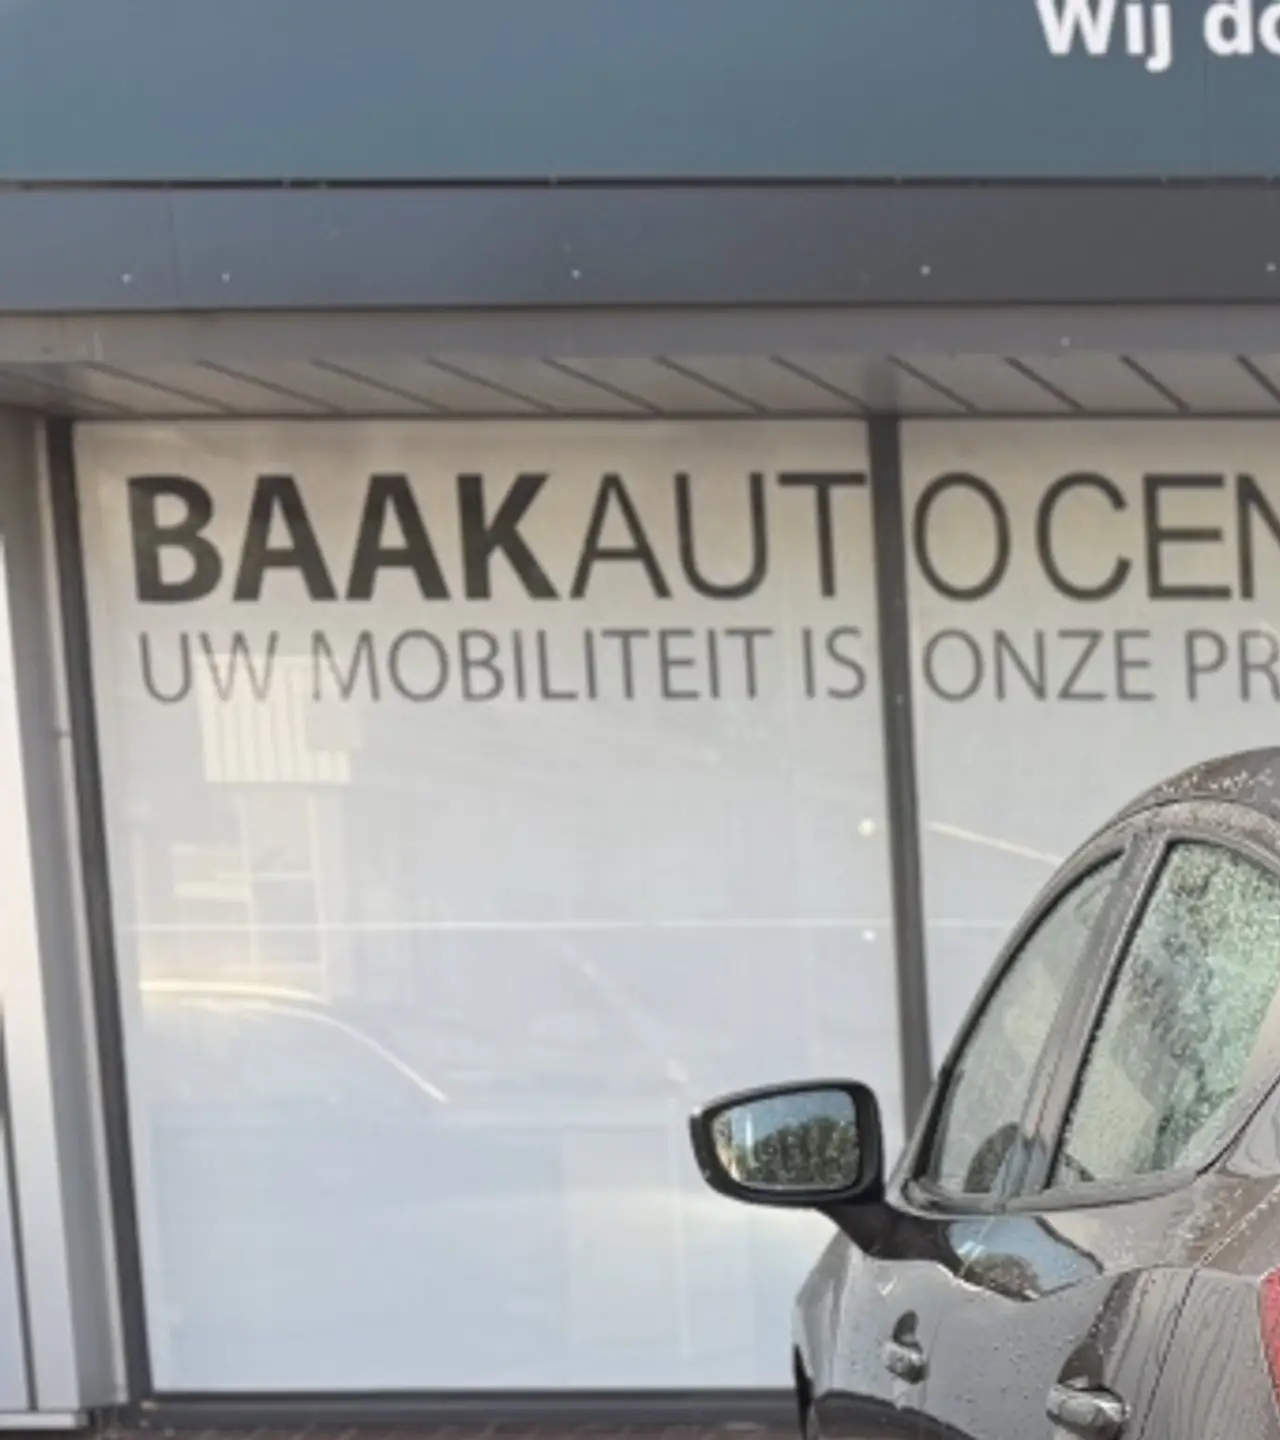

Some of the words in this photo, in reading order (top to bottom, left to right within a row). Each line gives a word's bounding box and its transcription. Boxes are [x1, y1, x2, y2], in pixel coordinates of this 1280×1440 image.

[1036, 0, 1172, 72] Wij
[138, 630, 280, 703] UW
[310, 627, 774, 703] MOBILITEIT
[802, 626, 868, 700] IS
[921, 628, 1156, 703] ONZE
